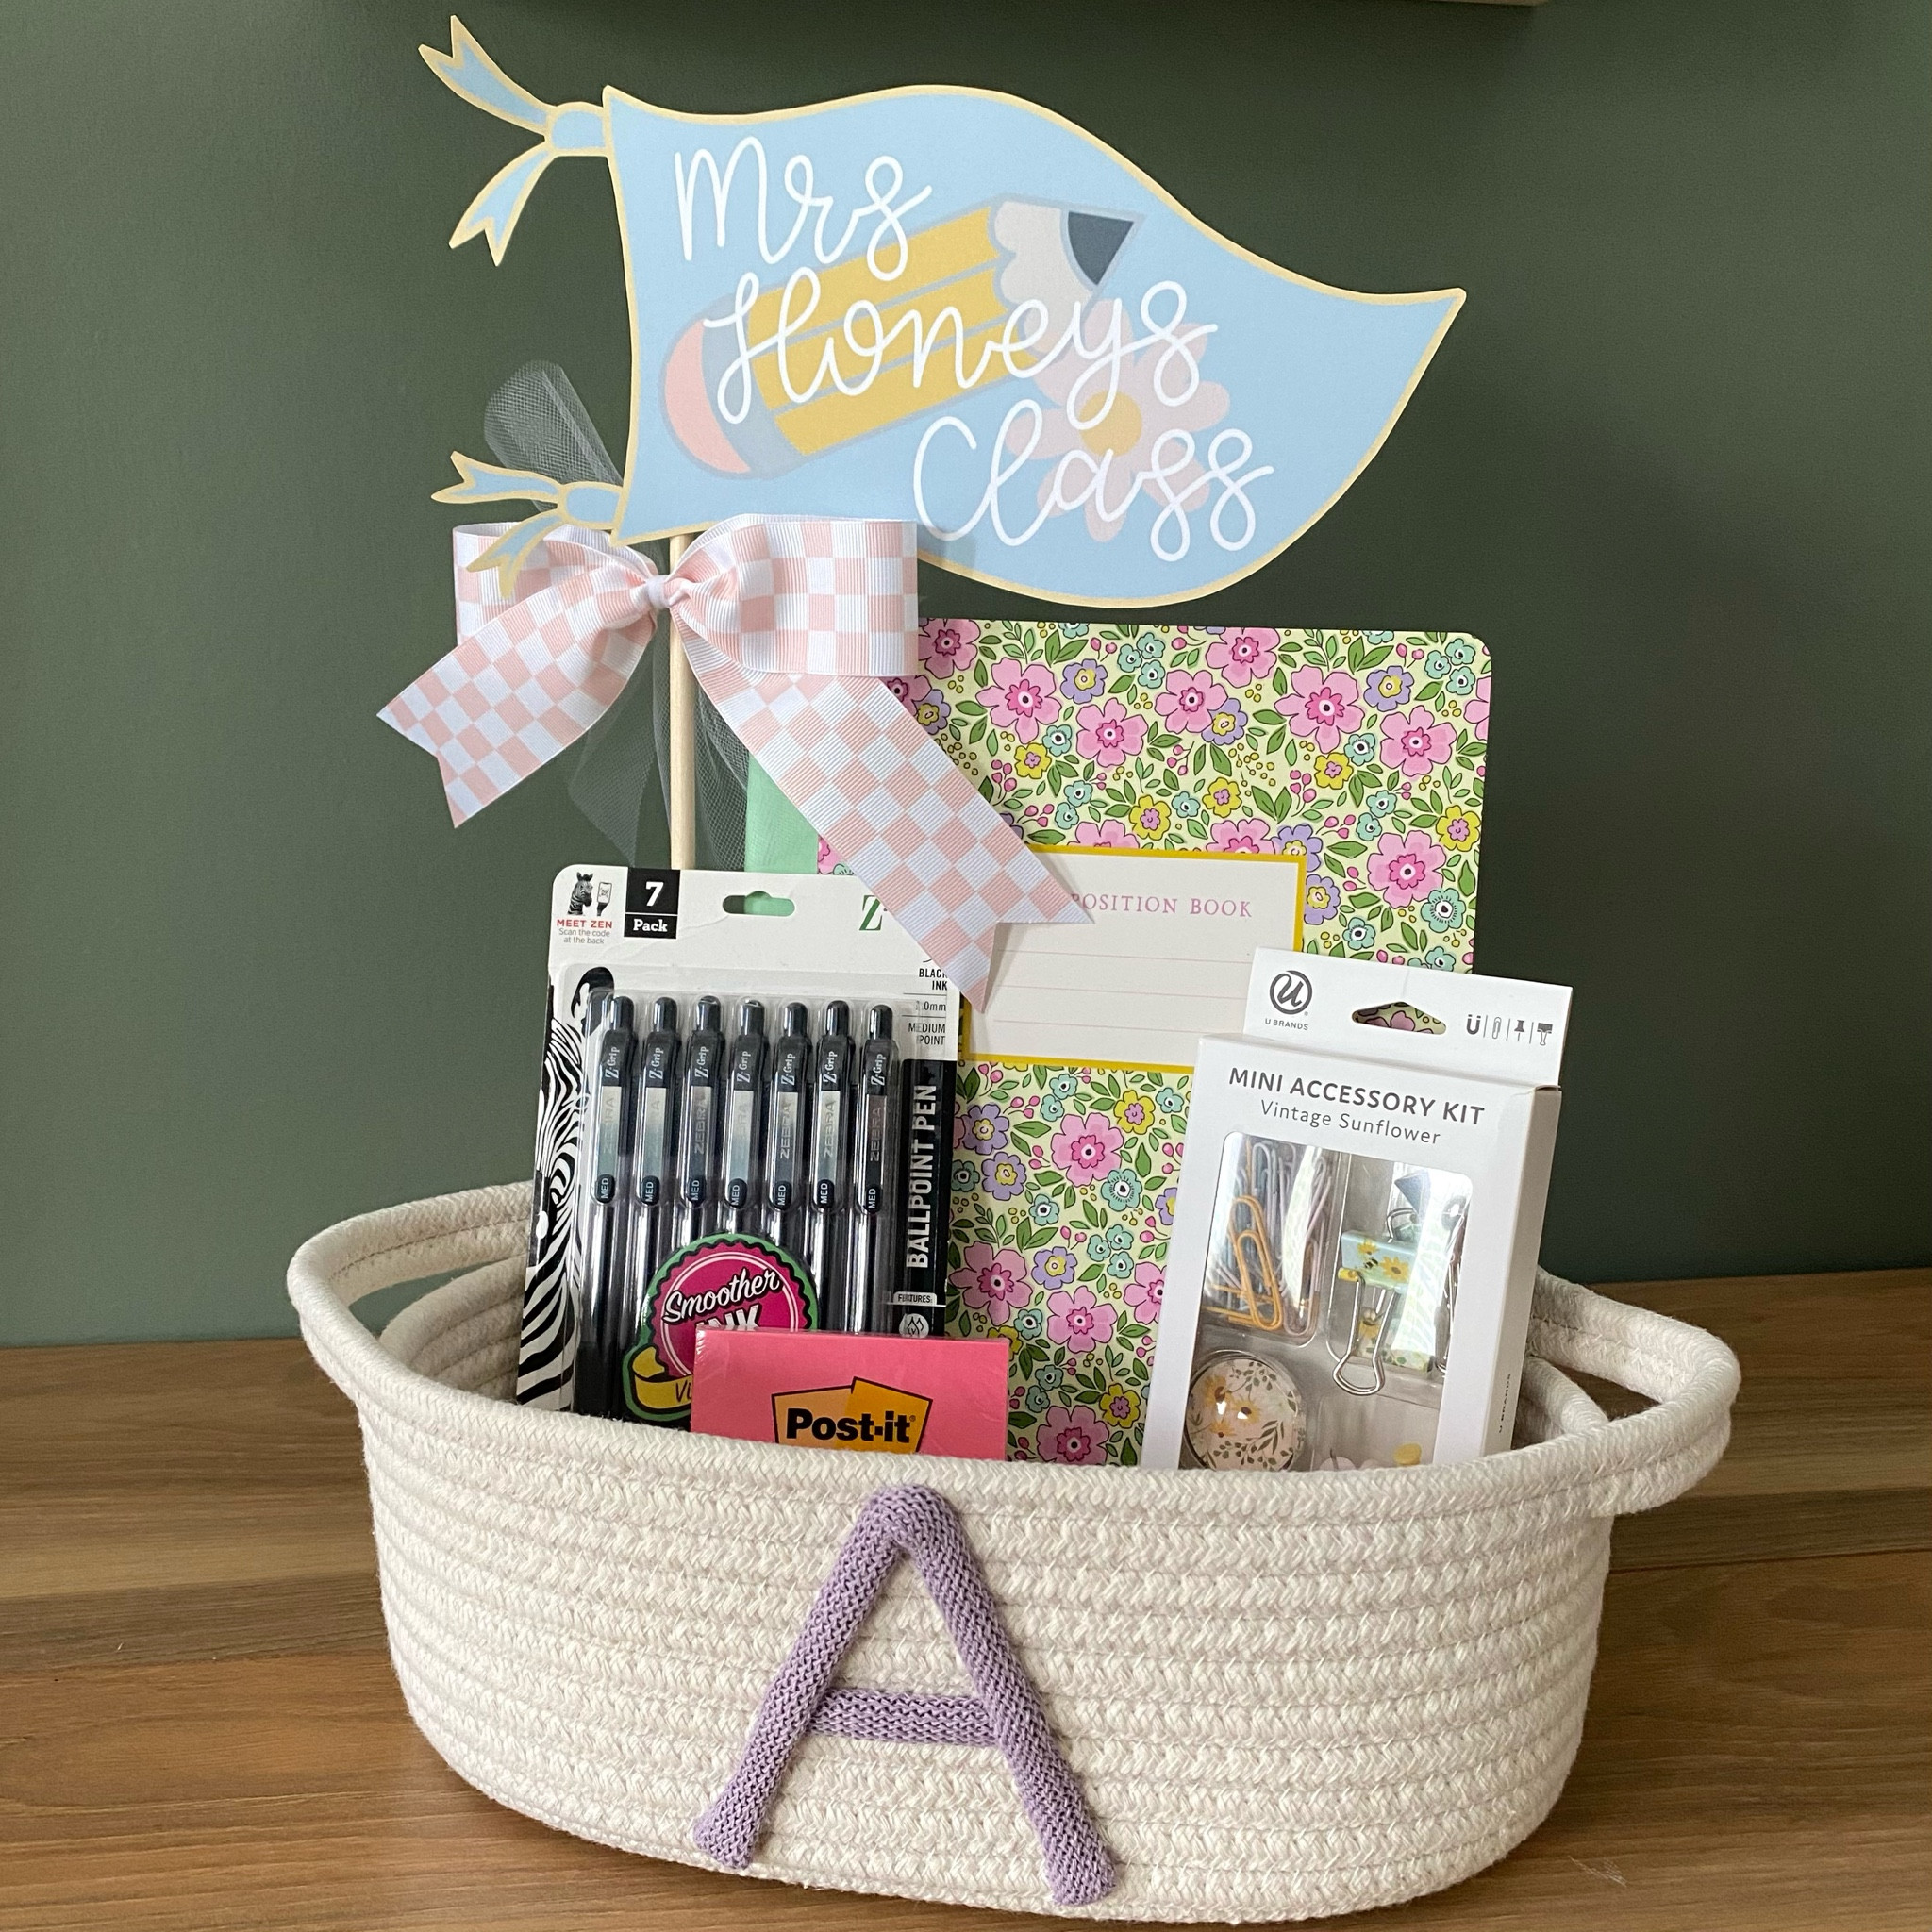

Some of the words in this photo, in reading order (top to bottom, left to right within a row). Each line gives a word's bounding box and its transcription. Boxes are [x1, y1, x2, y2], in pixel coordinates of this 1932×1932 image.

[675, 135, 933, 281] Mrs
[704, 265, 1218, 431] Honeys
[912, 399, 1274, 563] Class
[645, 880, 664, 907] 7
[1189, 897, 1253, 918] BOOK
[557, 919, 587, 928] MEET
[590, 920, 613, 929] ZEN
[578, 928, 591, 937] the
[633, 918, 668, 932] Pack
[587, 936, 605, 944] back
[931, 980, 948, 991] INK
[908, 1022, 946, 1034] MEDIUM
[1273, 1019, 1309, 1031] BRANDS
[916, 1035, 946, 1046] POINT
[1229, 1067, 1283, 1092] MINI
[1290, 1077, 1436, 1117] ACCESSORY
[1443, 1101, 1485, 1124] KIT
[912, 1085, 937, 1131] PEN
[1260, 1099, 1332, 1127] Vintage
[1339, 1113, 1441, 1144] Sunflower
[870, 1107, 881, 1161] ZEBRA
[601, 1177, 609, 1198] MED
[645, 1181, 654, 1202] MED
[731, 1184, 740, 1206] MED
[820, 1183, 828, 1204] MED
[868, 1188, 876, 1208] MED
[906, 1139, 934, 1268] BALLPOINT
[662, 1268, 780, 1323] Smoother
[692, 1484, 1116, 1905] A
